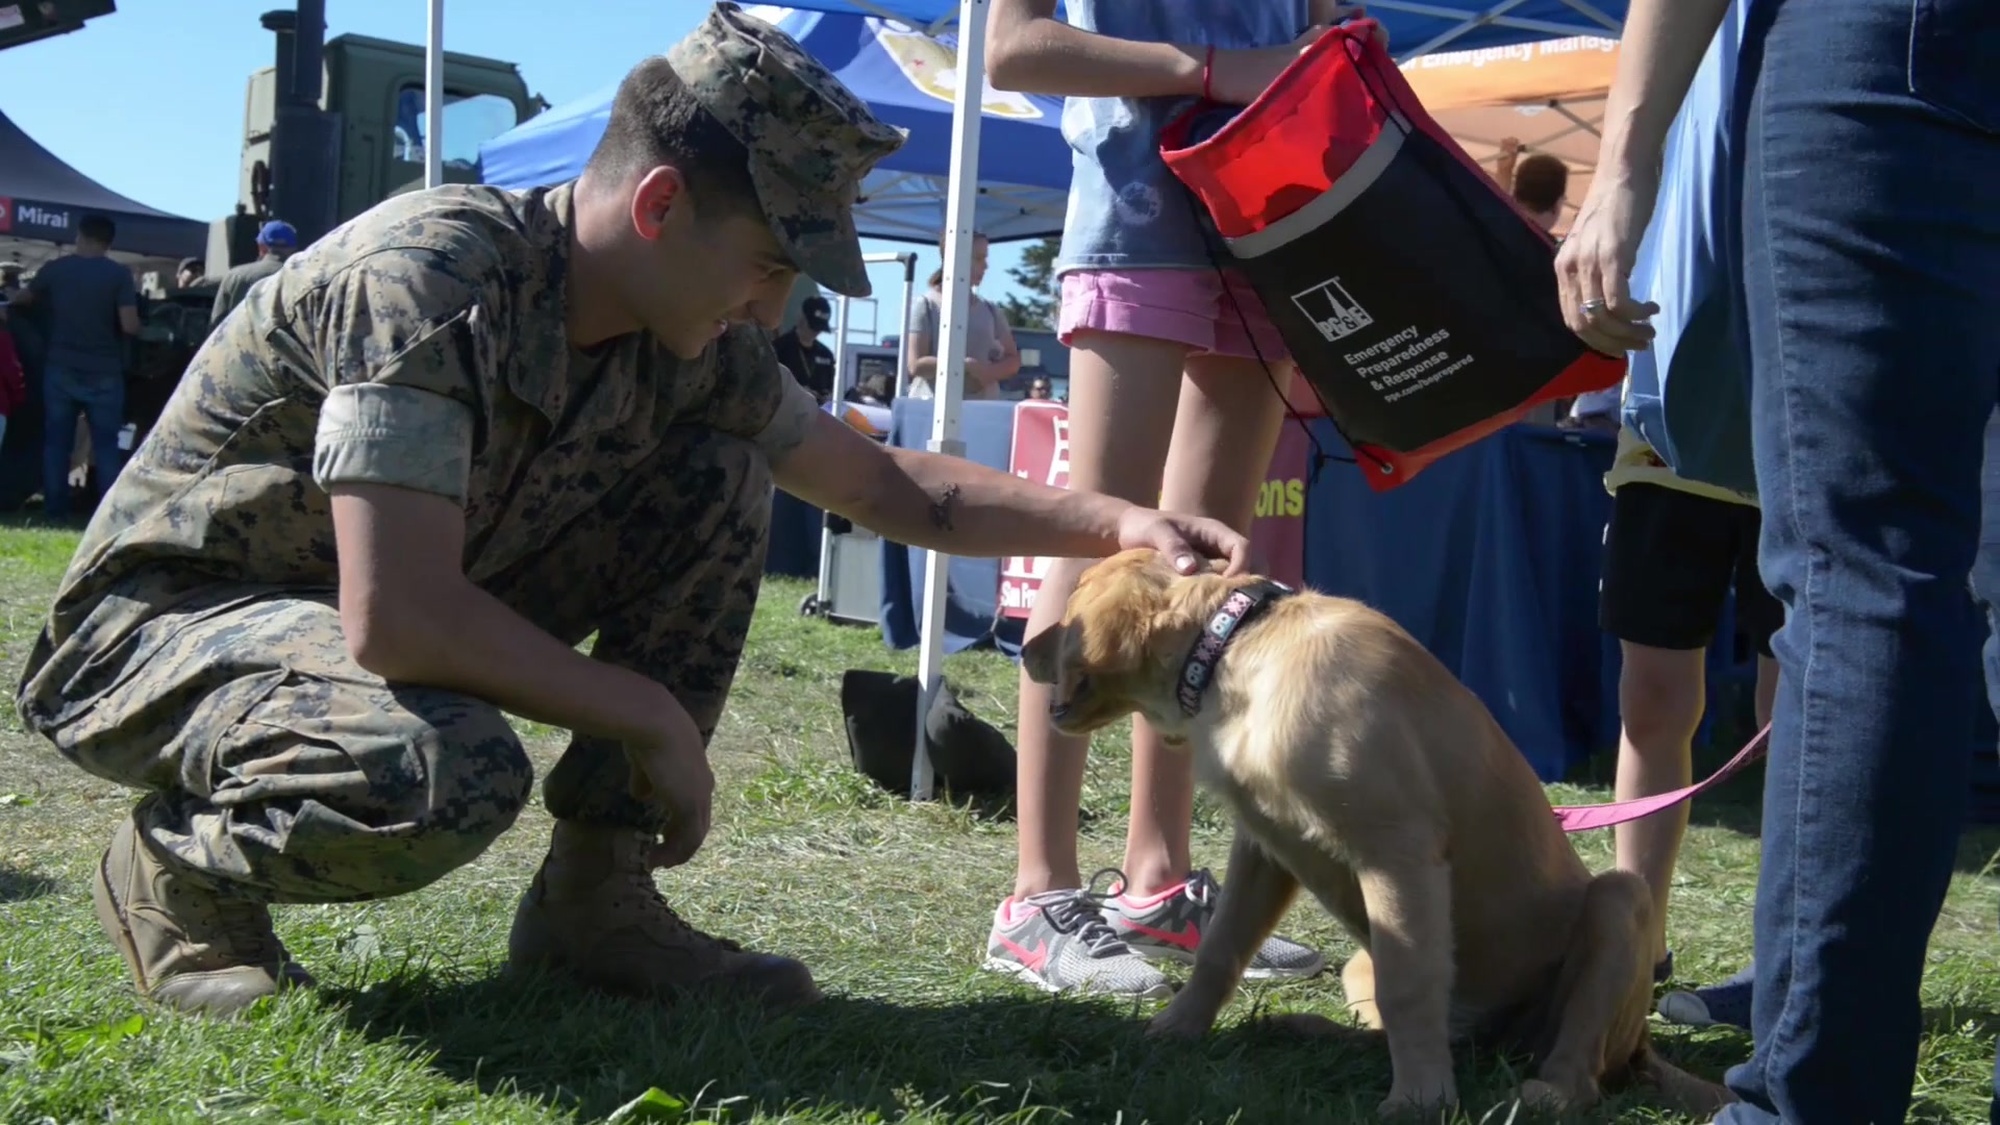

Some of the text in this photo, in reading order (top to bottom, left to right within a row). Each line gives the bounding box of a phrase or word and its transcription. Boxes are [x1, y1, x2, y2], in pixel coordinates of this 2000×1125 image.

[17, 205, 69, 228] Mirai
[1315, 305, 1371, 340] PG&E
[1343, 325, 1418, 365] Emergency
[1356, 328, 1450, 378] Preparedness
[1370, 350, 1449, 391] & Response
